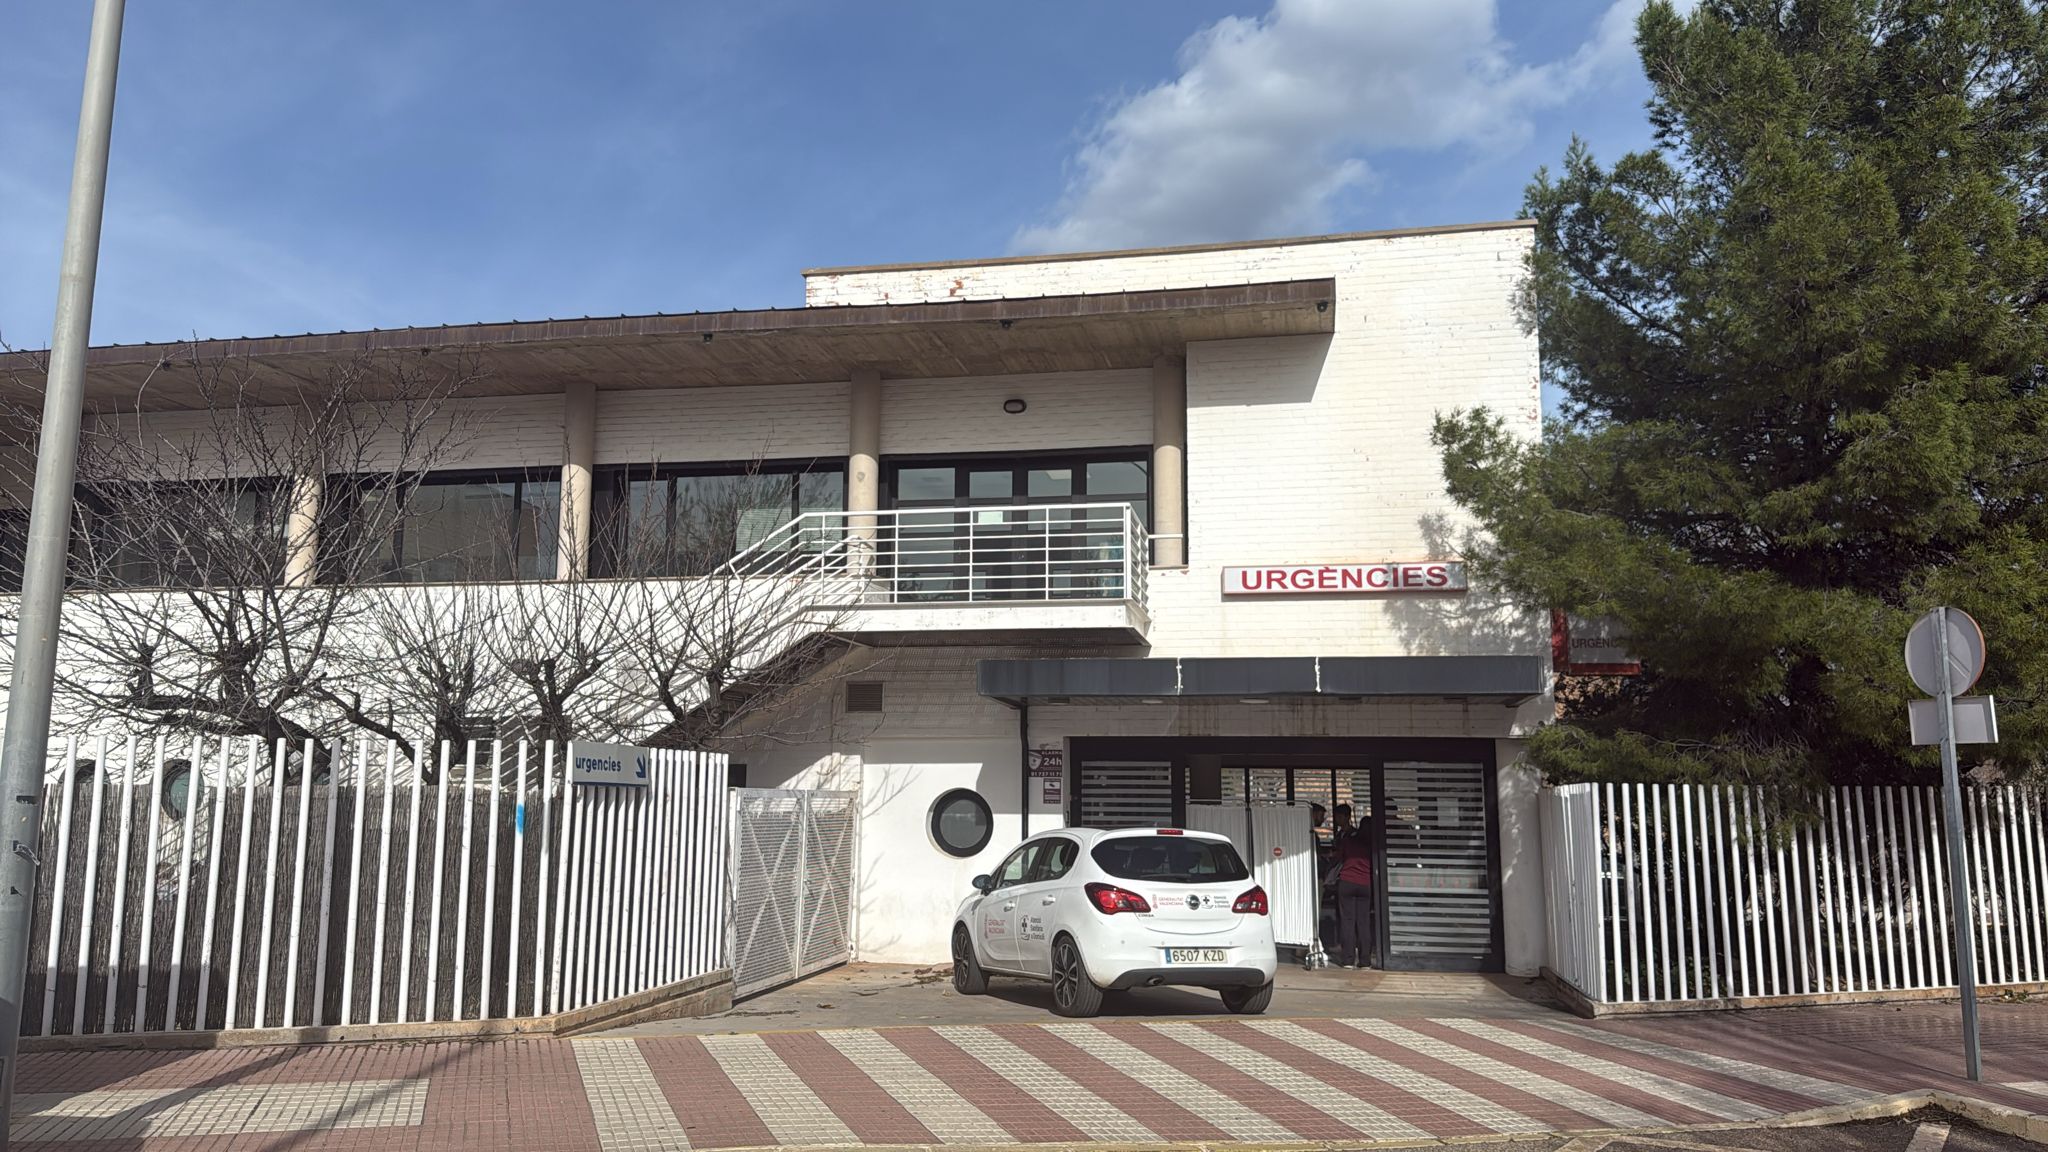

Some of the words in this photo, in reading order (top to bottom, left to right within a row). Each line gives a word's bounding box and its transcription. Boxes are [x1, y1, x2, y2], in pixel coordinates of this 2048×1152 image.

[1241, 566, 1448, 590] URGÈNCIES
[575, 755, 622, 773] urgencies
[1043, 757, 1062, 766] 24h
[1172, 950, 1200, 961] 6507
[1203, 950, 1224, 961] KZD
